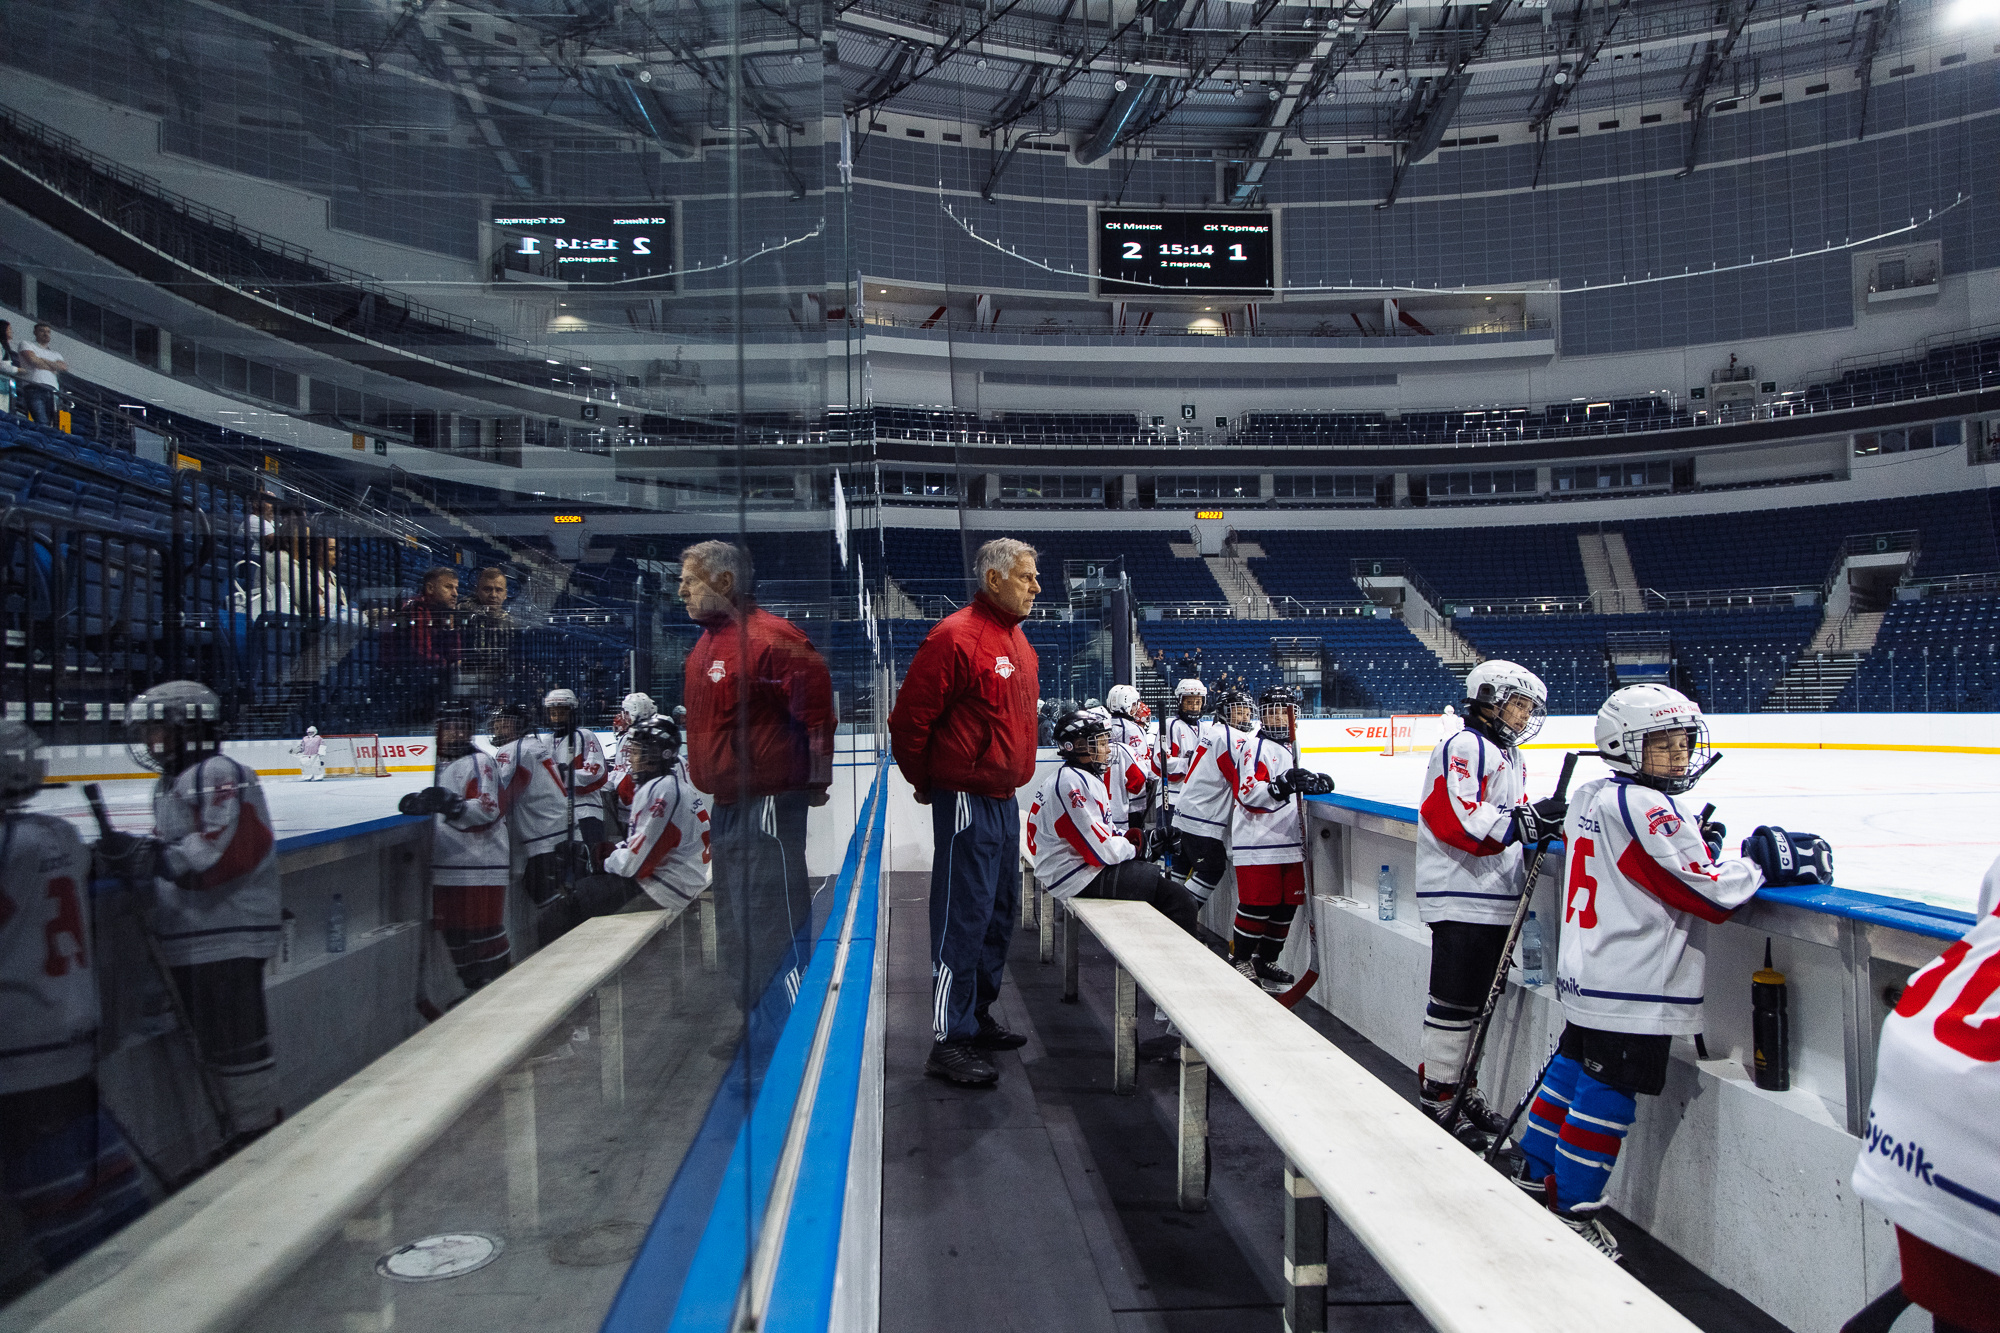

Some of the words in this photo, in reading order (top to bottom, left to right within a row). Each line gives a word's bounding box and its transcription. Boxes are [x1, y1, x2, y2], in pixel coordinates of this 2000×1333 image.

[1105, 222, 1121, 230] СК
[1123, 222, 1163, 231] Минск
[1122, 241, 1143, 259] 2
[1158, 243, 1215, 255] 15:14
[1228, 243, 1248, 261] 1
[1169, 261, 1211, 269] период
[1184, 407, 1193, 417] D
[1876, 539, 1888, 551] D
[1087, 565, 1096, 576] D
[1373, 564, 1382, 574] D
